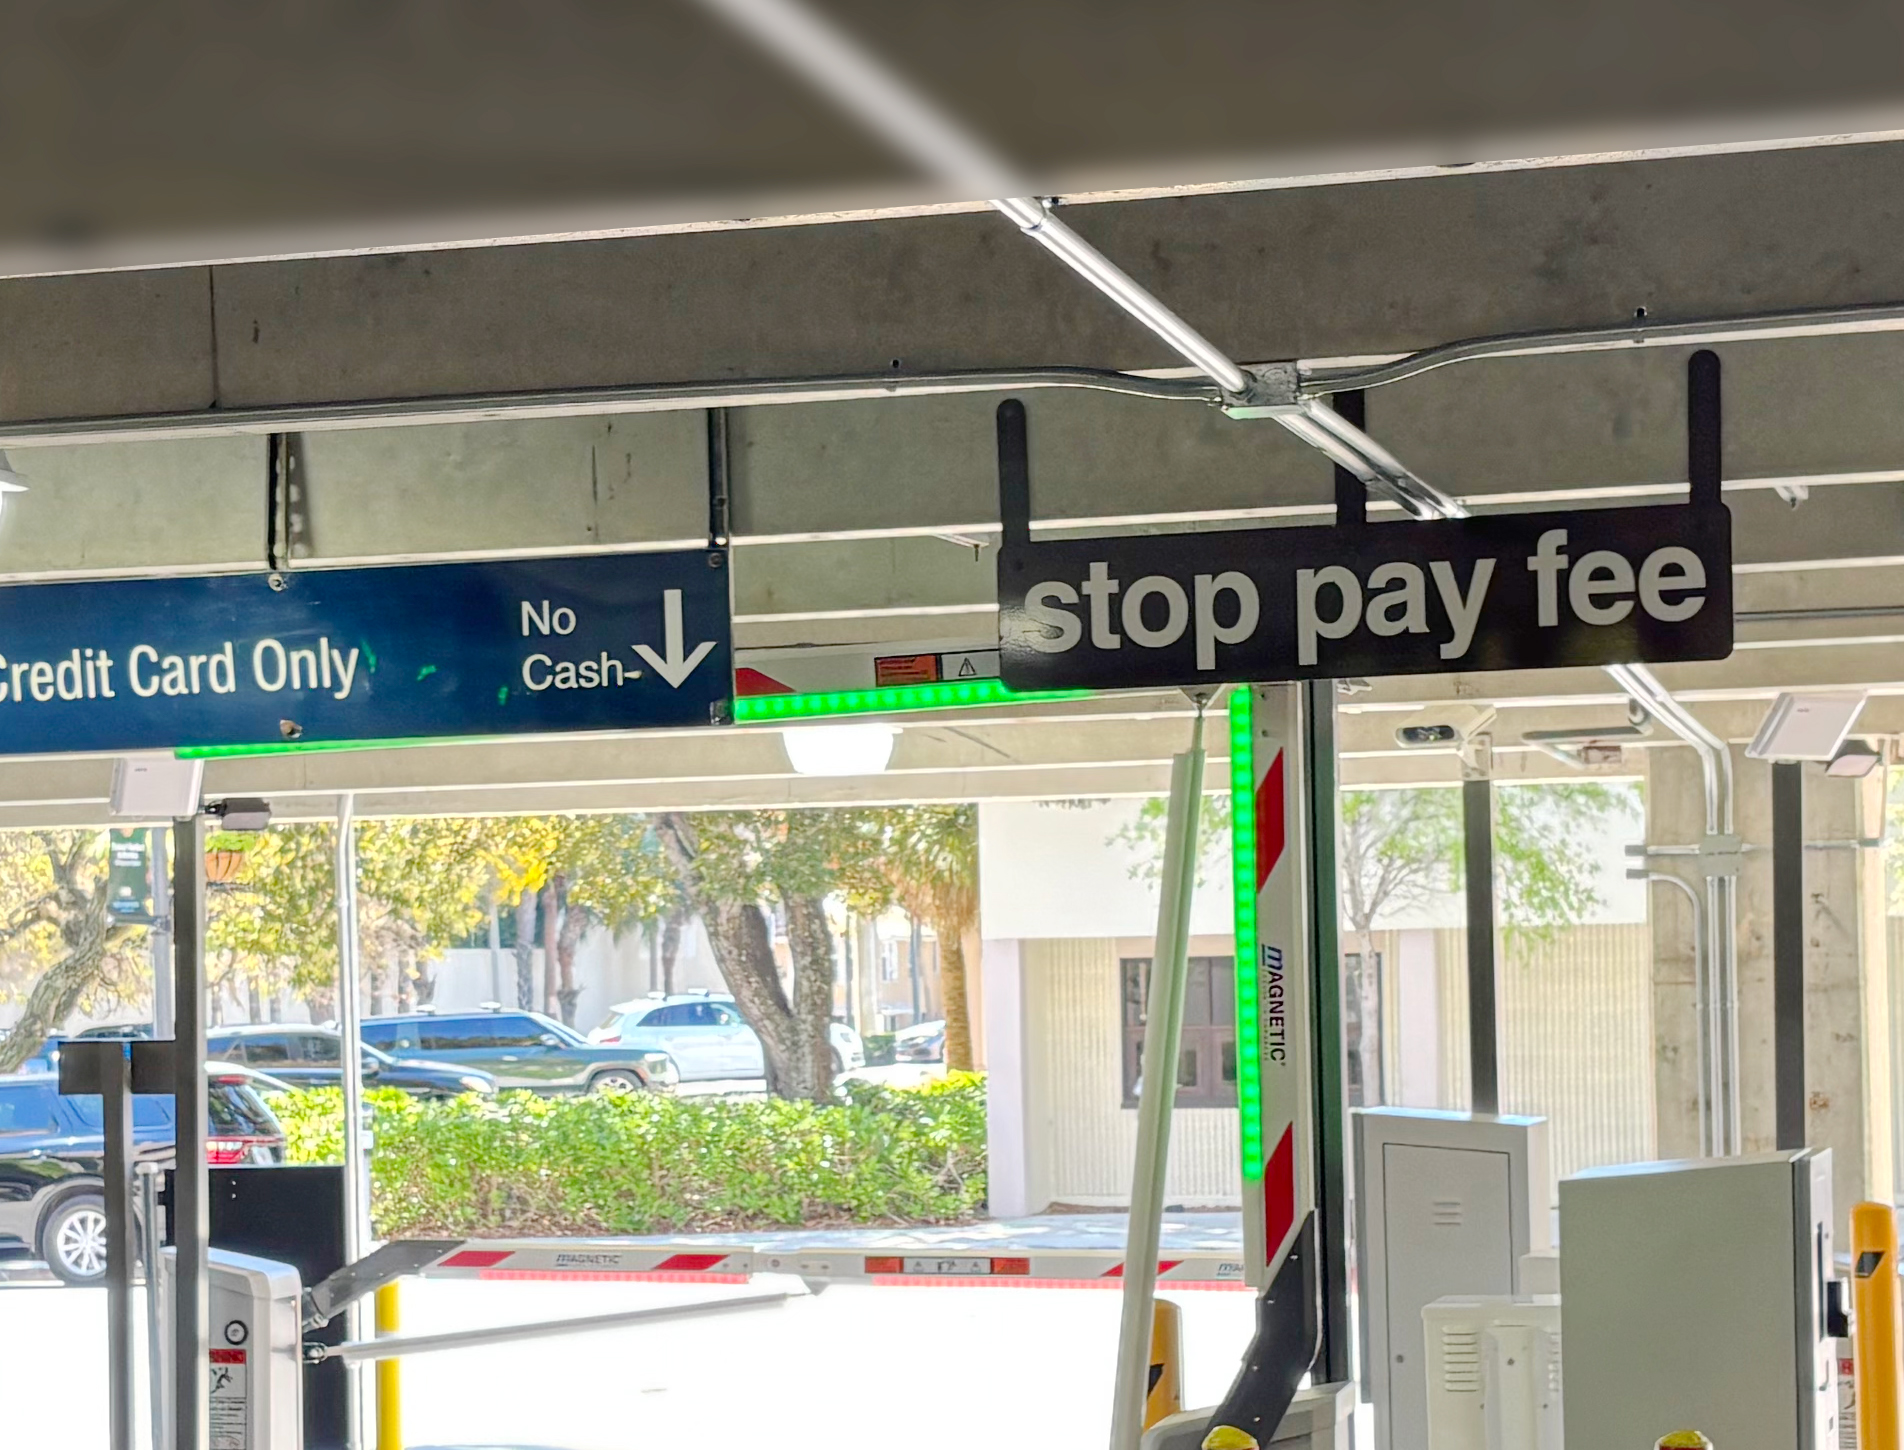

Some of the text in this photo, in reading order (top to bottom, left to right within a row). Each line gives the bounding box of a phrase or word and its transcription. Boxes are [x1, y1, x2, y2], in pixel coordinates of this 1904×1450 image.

[521, 600, 576, 636] No
[1024, 529, 1706, 670] stop pay fee
[128, 640, 237, 698] Card
[252, 635, 360, 700] Only
